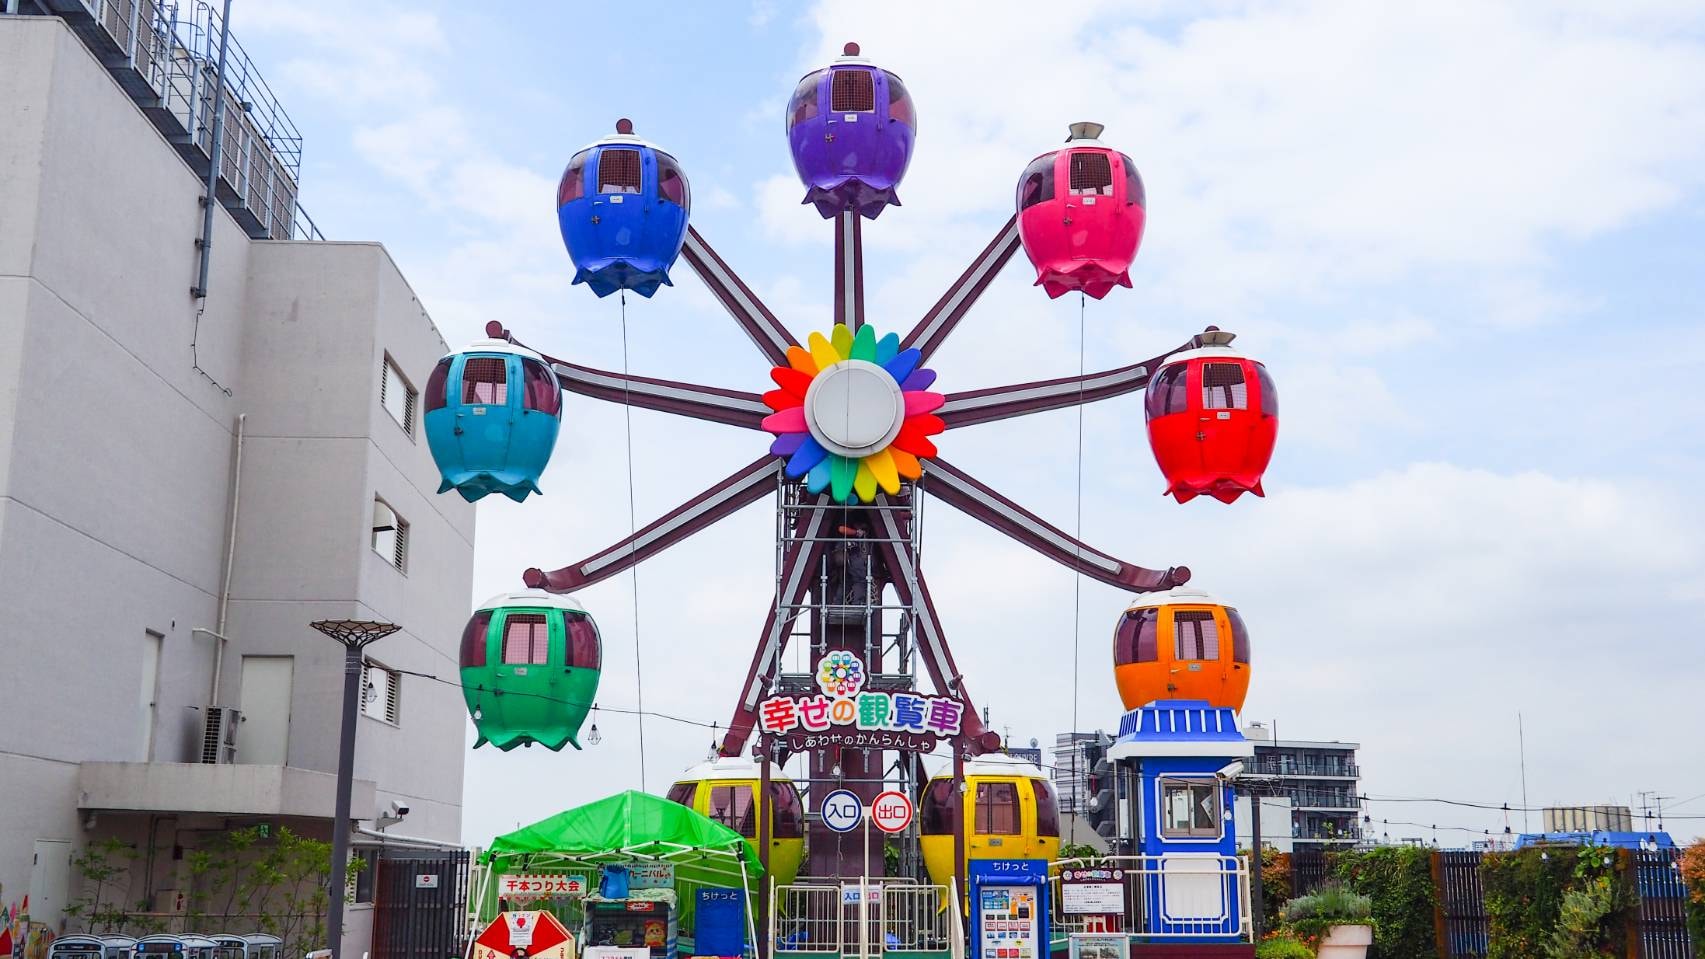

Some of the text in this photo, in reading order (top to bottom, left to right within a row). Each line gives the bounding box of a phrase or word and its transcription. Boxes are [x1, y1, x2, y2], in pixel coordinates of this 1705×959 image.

[763, 694, 961, 732] 幸せの観覧車
[792, 732, 931, 751] しあわせのかんらんしゃ
[827, 803, 857, 819] 入口
[878, 804, 906, 819] 出口
[992, 861, 1029, 871] ちけっと
[506, 880, 581, 892] 千本つり大会
[702, 891, 738, 901] ちけっと
[844, 892, 861, 901] 入口
